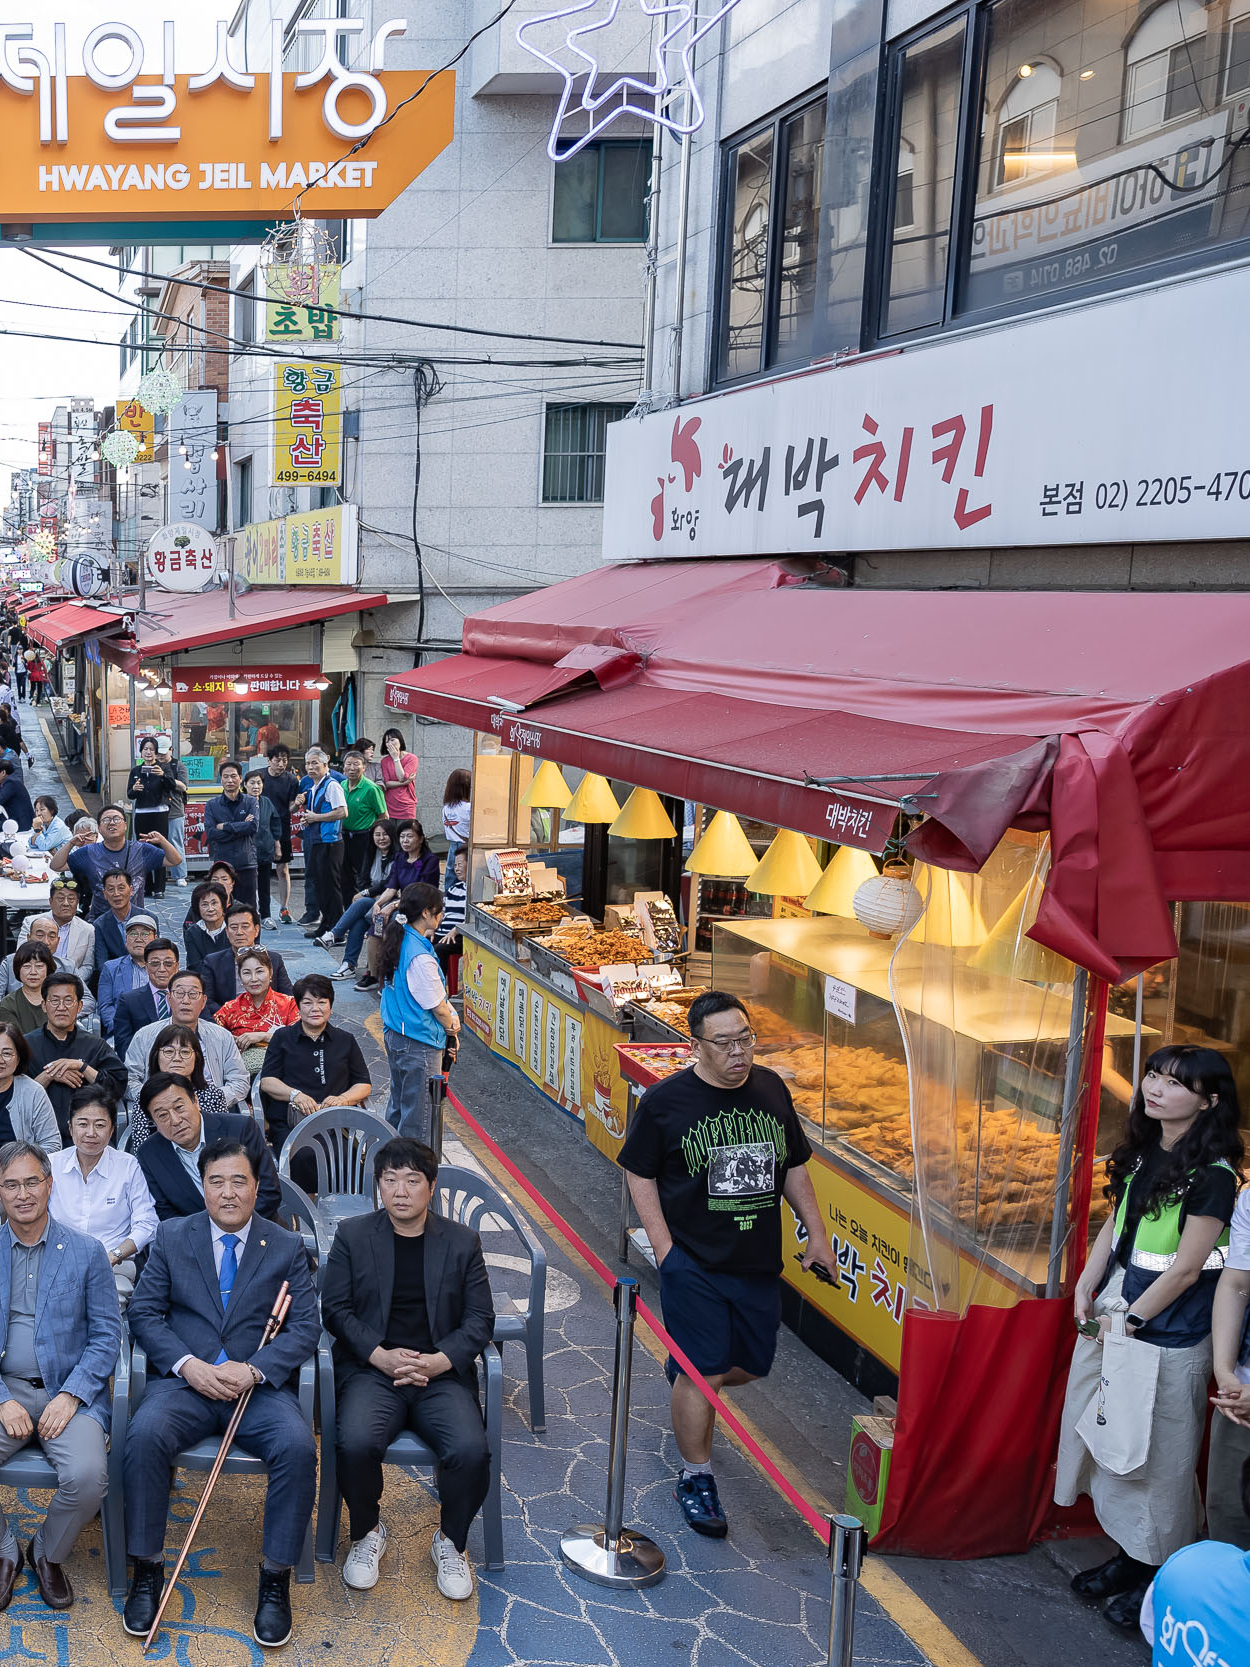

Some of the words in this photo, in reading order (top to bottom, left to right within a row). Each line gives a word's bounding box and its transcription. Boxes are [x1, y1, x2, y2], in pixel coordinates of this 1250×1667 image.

[38, 164, 190, 192] HWAYANG
[199, 162, 252, 190] JEIL
[258, 161, 378, 190] MARKET
[269, 302, 338, 340] 초밥
[283, 366, 337, 396] 황금
[288, 397, 327, 469] 축산
[277, 469, 336, 482] 499-6494
[721, 403, 994, 539] 대박치킨
[1039, 482, 1082, 517] 본점
[1095, 479, 1129, 511] 02)
[291, 519, 335, 562] 황금축산
[670, 507, 700, 541] 화양
[153, 549, 213, 574] 황금축산
[250, 680, 301, 692] 판매합니다
[825, 803, 873, 838] 대박치킨
[829, 1203, 847, 1230] 나는
[850, 1219, 868, 1245] 오늘
[871, 1233, 901, 1267] 치킨이
